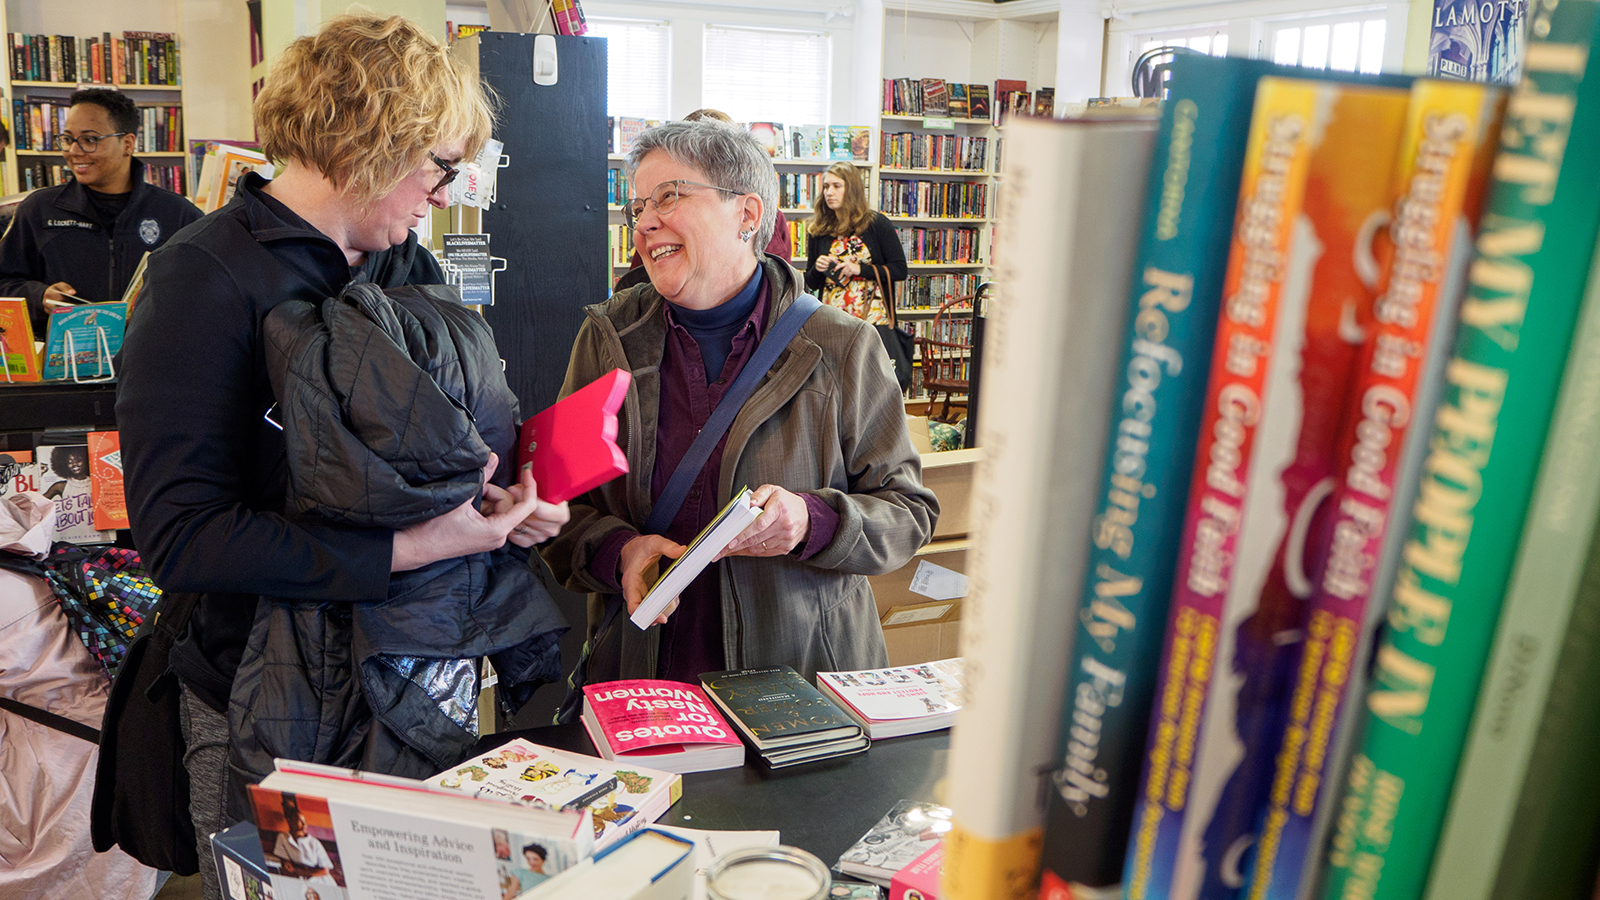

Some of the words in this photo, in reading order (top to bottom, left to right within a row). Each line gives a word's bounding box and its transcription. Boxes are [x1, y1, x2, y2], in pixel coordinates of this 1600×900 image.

[1434, 0, 1523, 28] LAMOTT
[1441, 59, 1460, 75] PLAN
[1226, 113, 1308, 328] Struggling
[1373, 111, 1472, 328] Struggling
[1458, 213, 1546, 353] MY
[1224, 332, 1272, 379] in
[1371, 332, 1423, 379] in
[1092, 266, 1195, 558] Refocusing
[1206, 383, 1261, 498] Good
[1347, 383, 1412, 498] Good
[1387, 357, 1510, 647] PEOPLE
[1186, 497, 1242, 598] Faith
[1321, 497, 1389, 600] Faith
[1079, 562, 1144, 654] My
[594, 687, 703, 703] Women
[626, 698, 710, 714] Nasty
[727, 681, 808, 701] MARY
[736, 697, 831, 715] POWER
[1366, 644, 1438, 736] IN
[615, 725, 727, 742] Quotes
[677, 712, 718, 726] for
[750, 713, 847, 736] WOMEN
[1053, 656, 1126, 818] Family
[350, 819, 430, 846] Empowering
[431, 834, 475, 852] Advice
[368, 838, 391, 852] and
[393, 840, 463, 865] Inspiration
